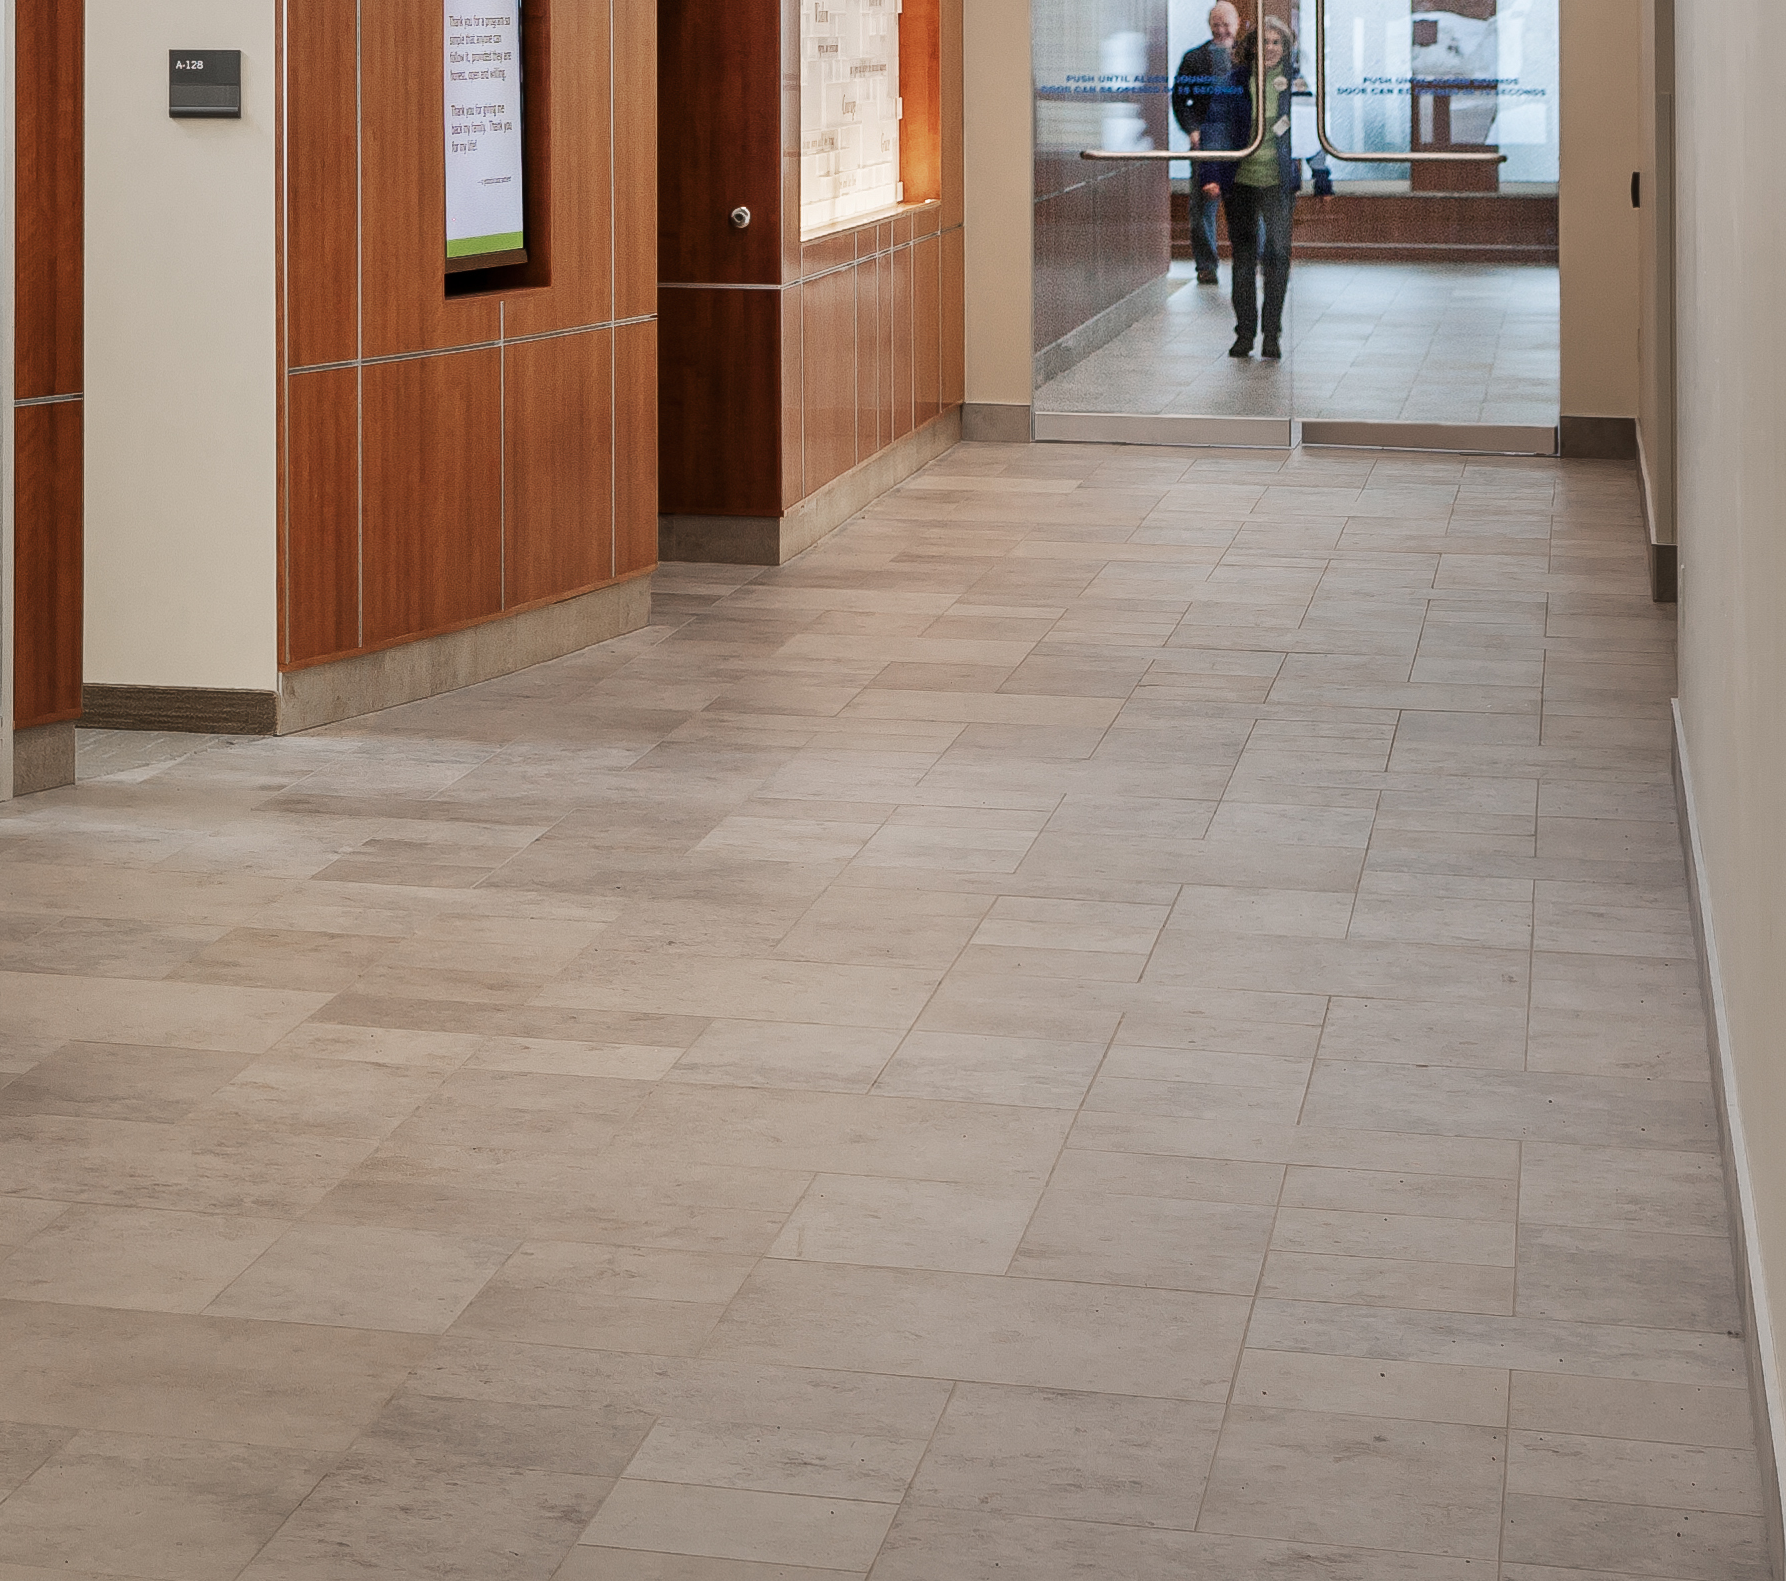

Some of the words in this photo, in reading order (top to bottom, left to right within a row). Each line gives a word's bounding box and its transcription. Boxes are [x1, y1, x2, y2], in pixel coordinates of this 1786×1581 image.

[449, 15, 464, 27] Thank
[464, 18, 473, 29] you
[472, 15, 481, 27] for
[175, 60, 204, 70] A-128
[1065, 75, 1095, 83] PUSH
[1098, 75, 1130, 83] UNTIL
[1363, 77, 1392, 85] PUSH
[450, 104, 465, 117] Thank
[465, 107, 475, 119] you
[475, 104, 483, 115] for
[451, 123, 463, 135] back
[463, 124, 471, 137] my
[488, 120, 503, 132] Thank
[503, 121, 513, 134] you
[451, 140, 460, 153] for
[459, 143, 468, 155] my
